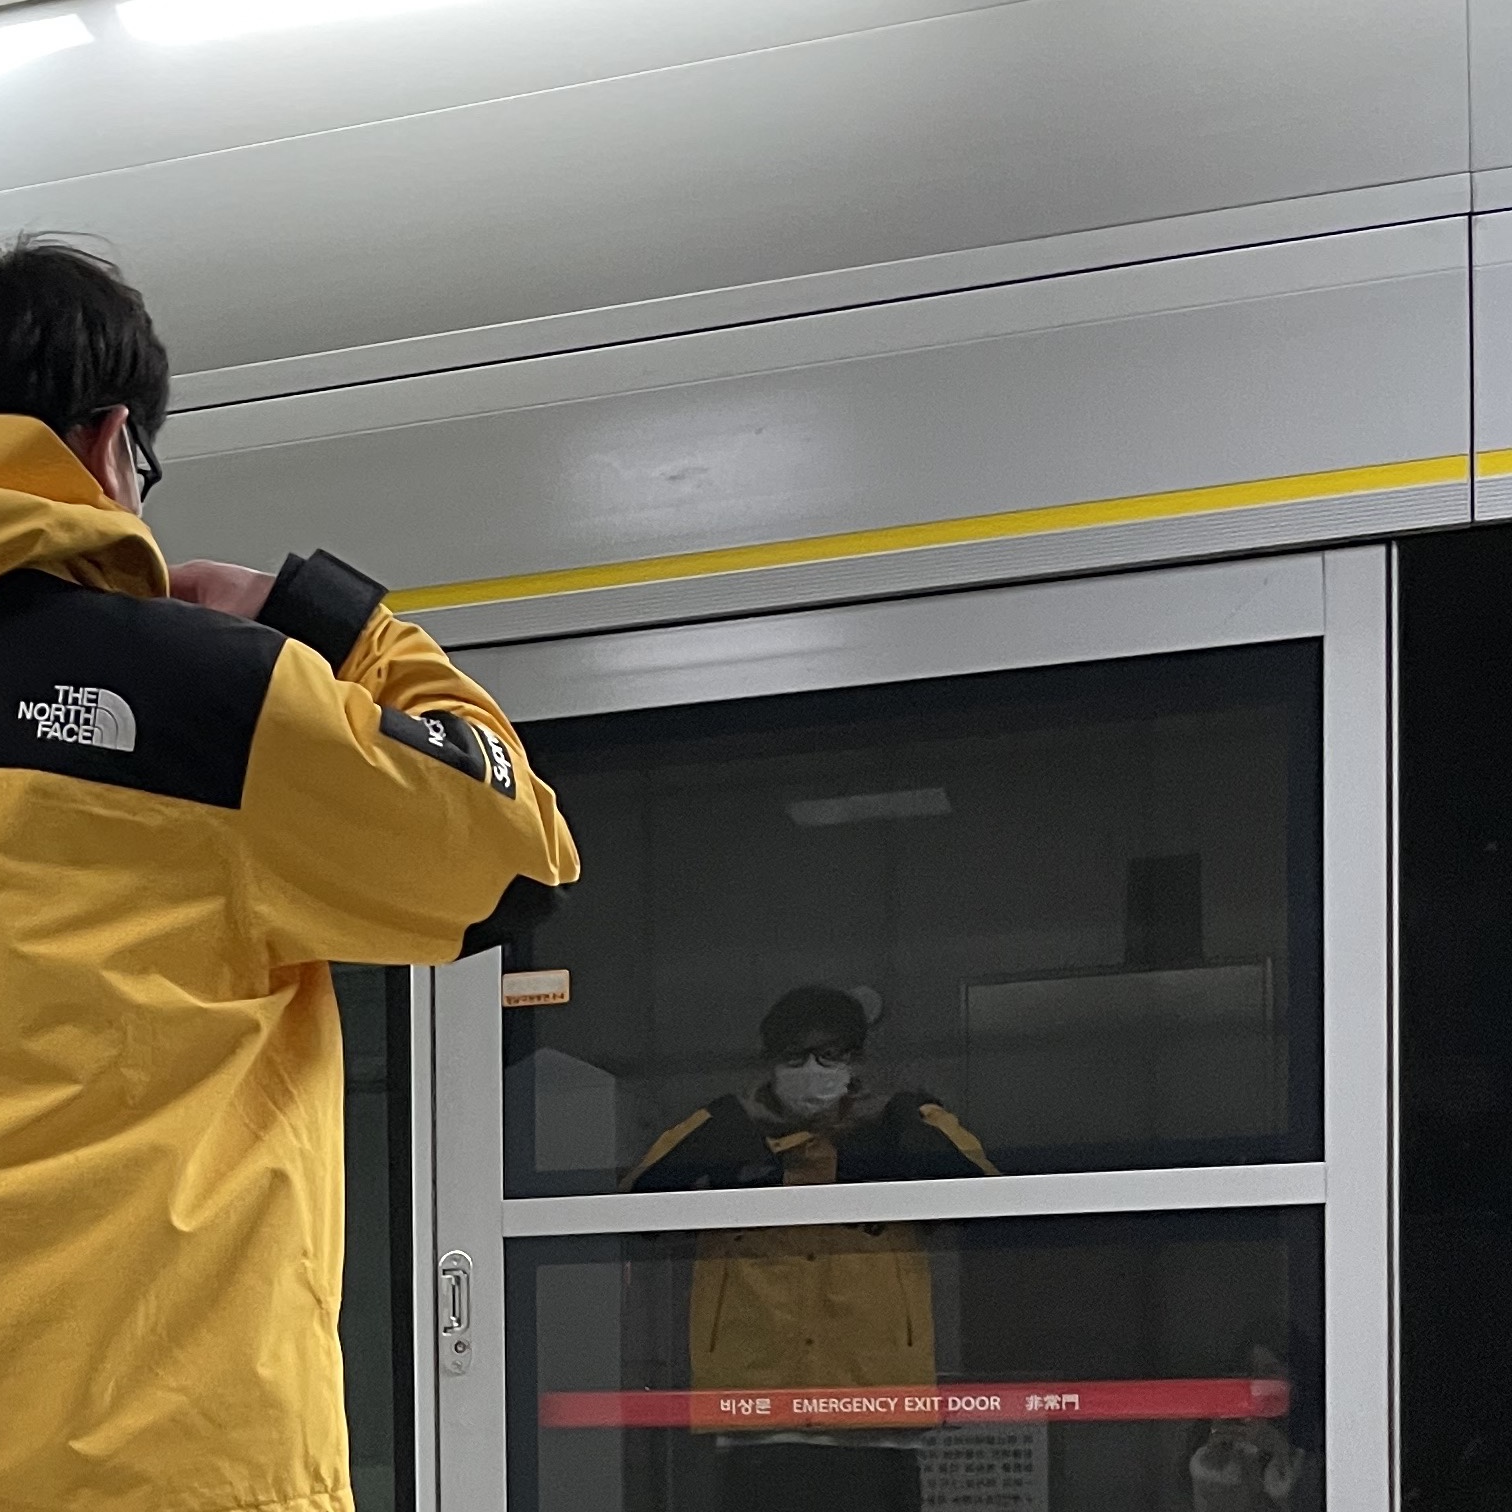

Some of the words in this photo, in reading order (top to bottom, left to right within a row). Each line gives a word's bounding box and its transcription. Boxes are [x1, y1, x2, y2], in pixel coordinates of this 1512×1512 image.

[54, 685, 99, 707] THE
[17, 701, 96, 726] NORTH
[37, 721, 93, 745] FACE
[720, 1398, 771, 1415] 비상문
[793, 1397, 896, 1413] EMERGENCY
[904, 1396, 943, 1412] EXIT
[947, 1395, 1001, 1411] DOOR
